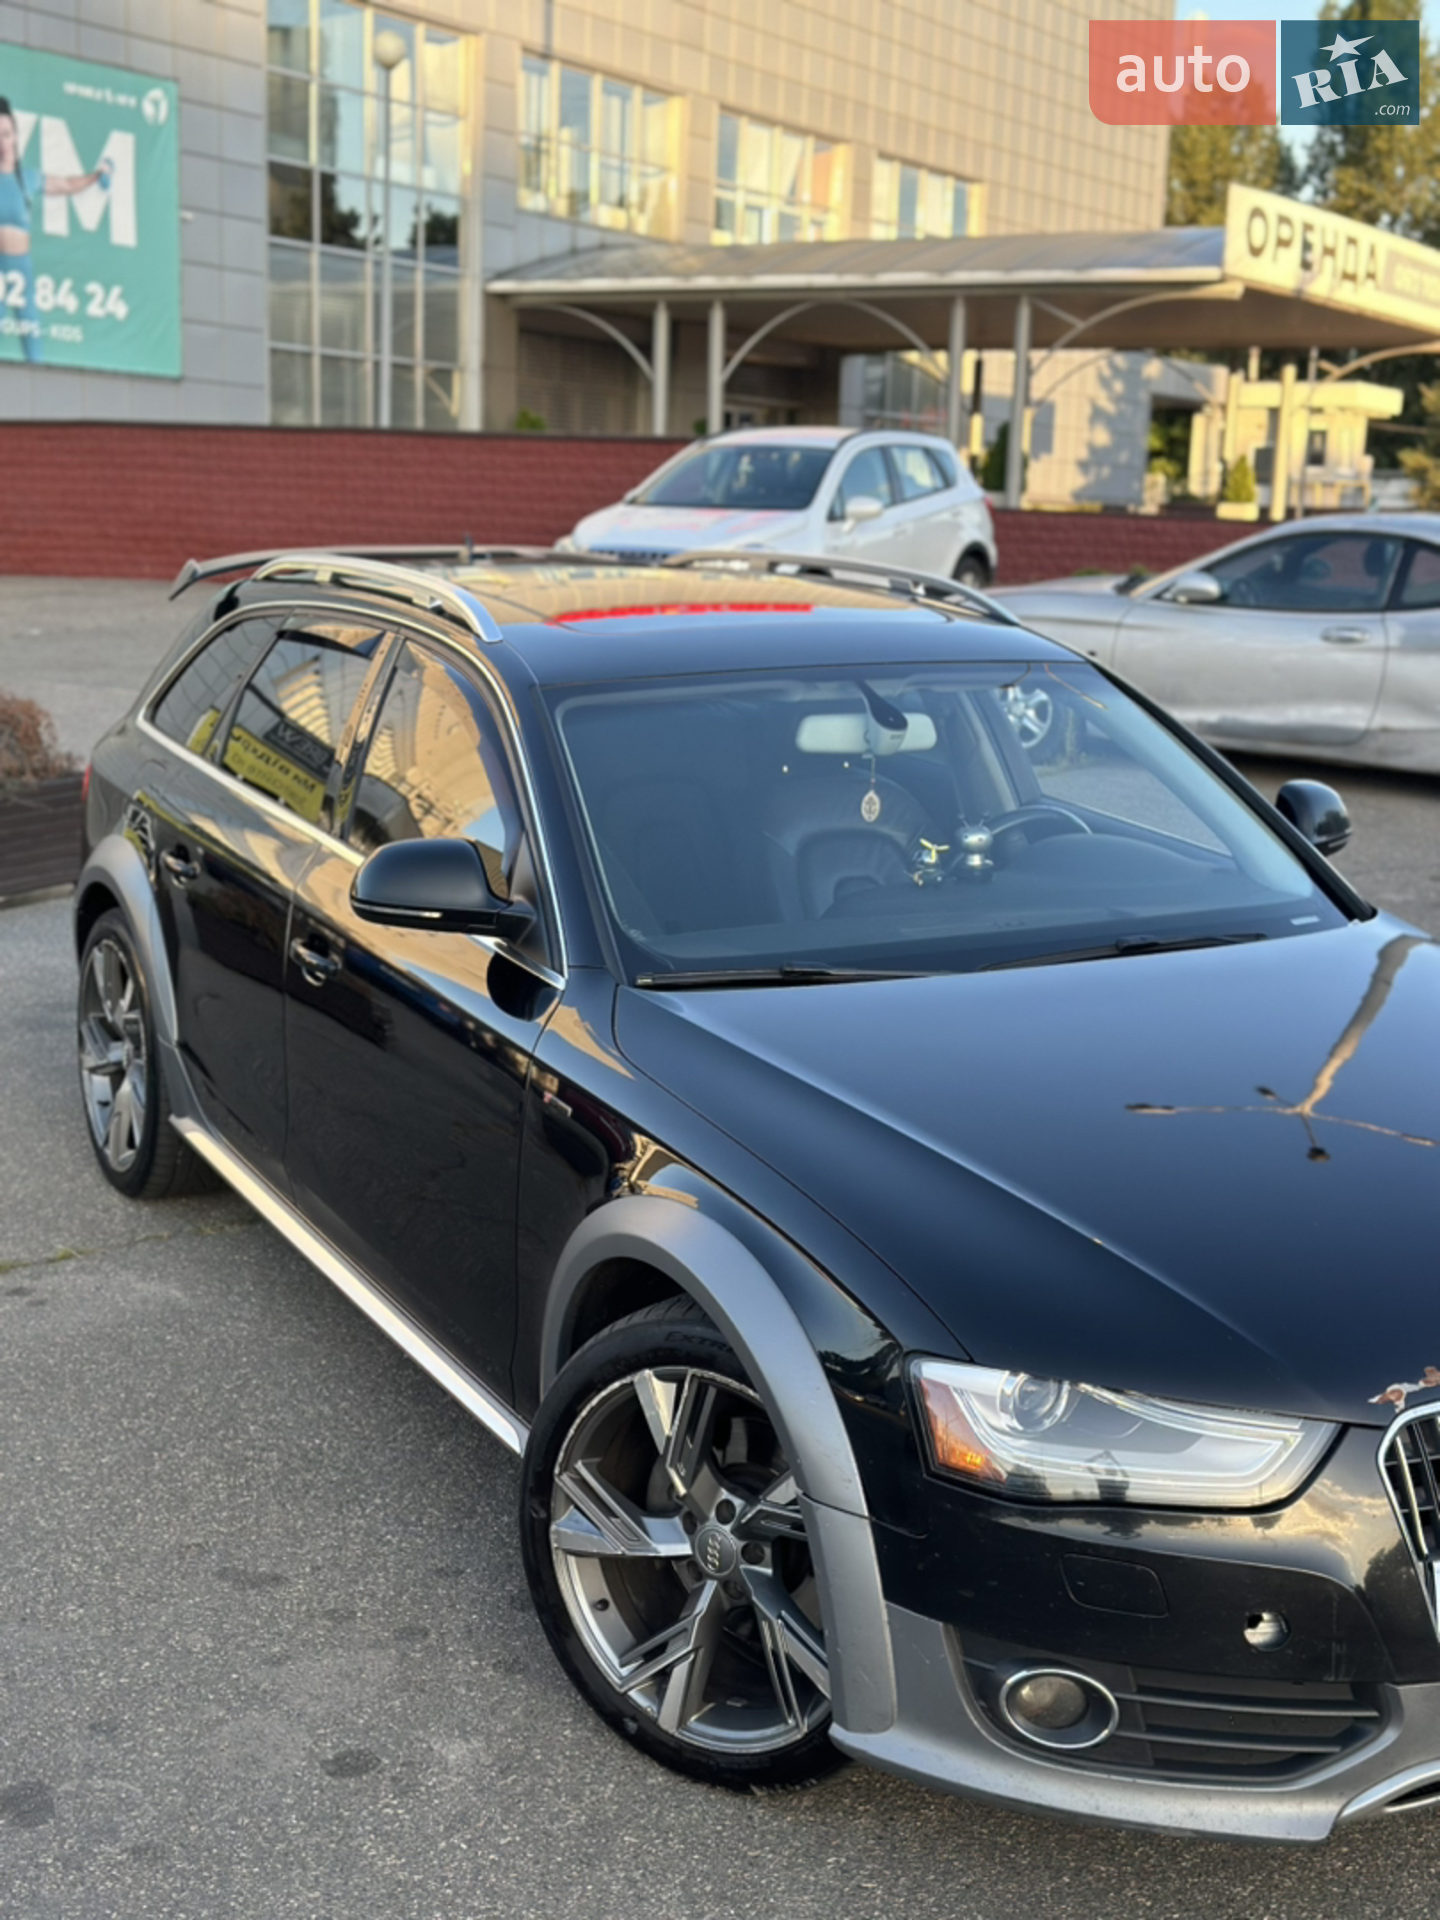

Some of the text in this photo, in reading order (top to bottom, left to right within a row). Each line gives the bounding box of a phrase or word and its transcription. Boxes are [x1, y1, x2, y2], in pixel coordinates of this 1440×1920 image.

[1246, 206, 1379, 291] ОРЕНДА
[0, 269, 129, 321] 2 84 24
[664, 1331, 733, 1353] EXTR
